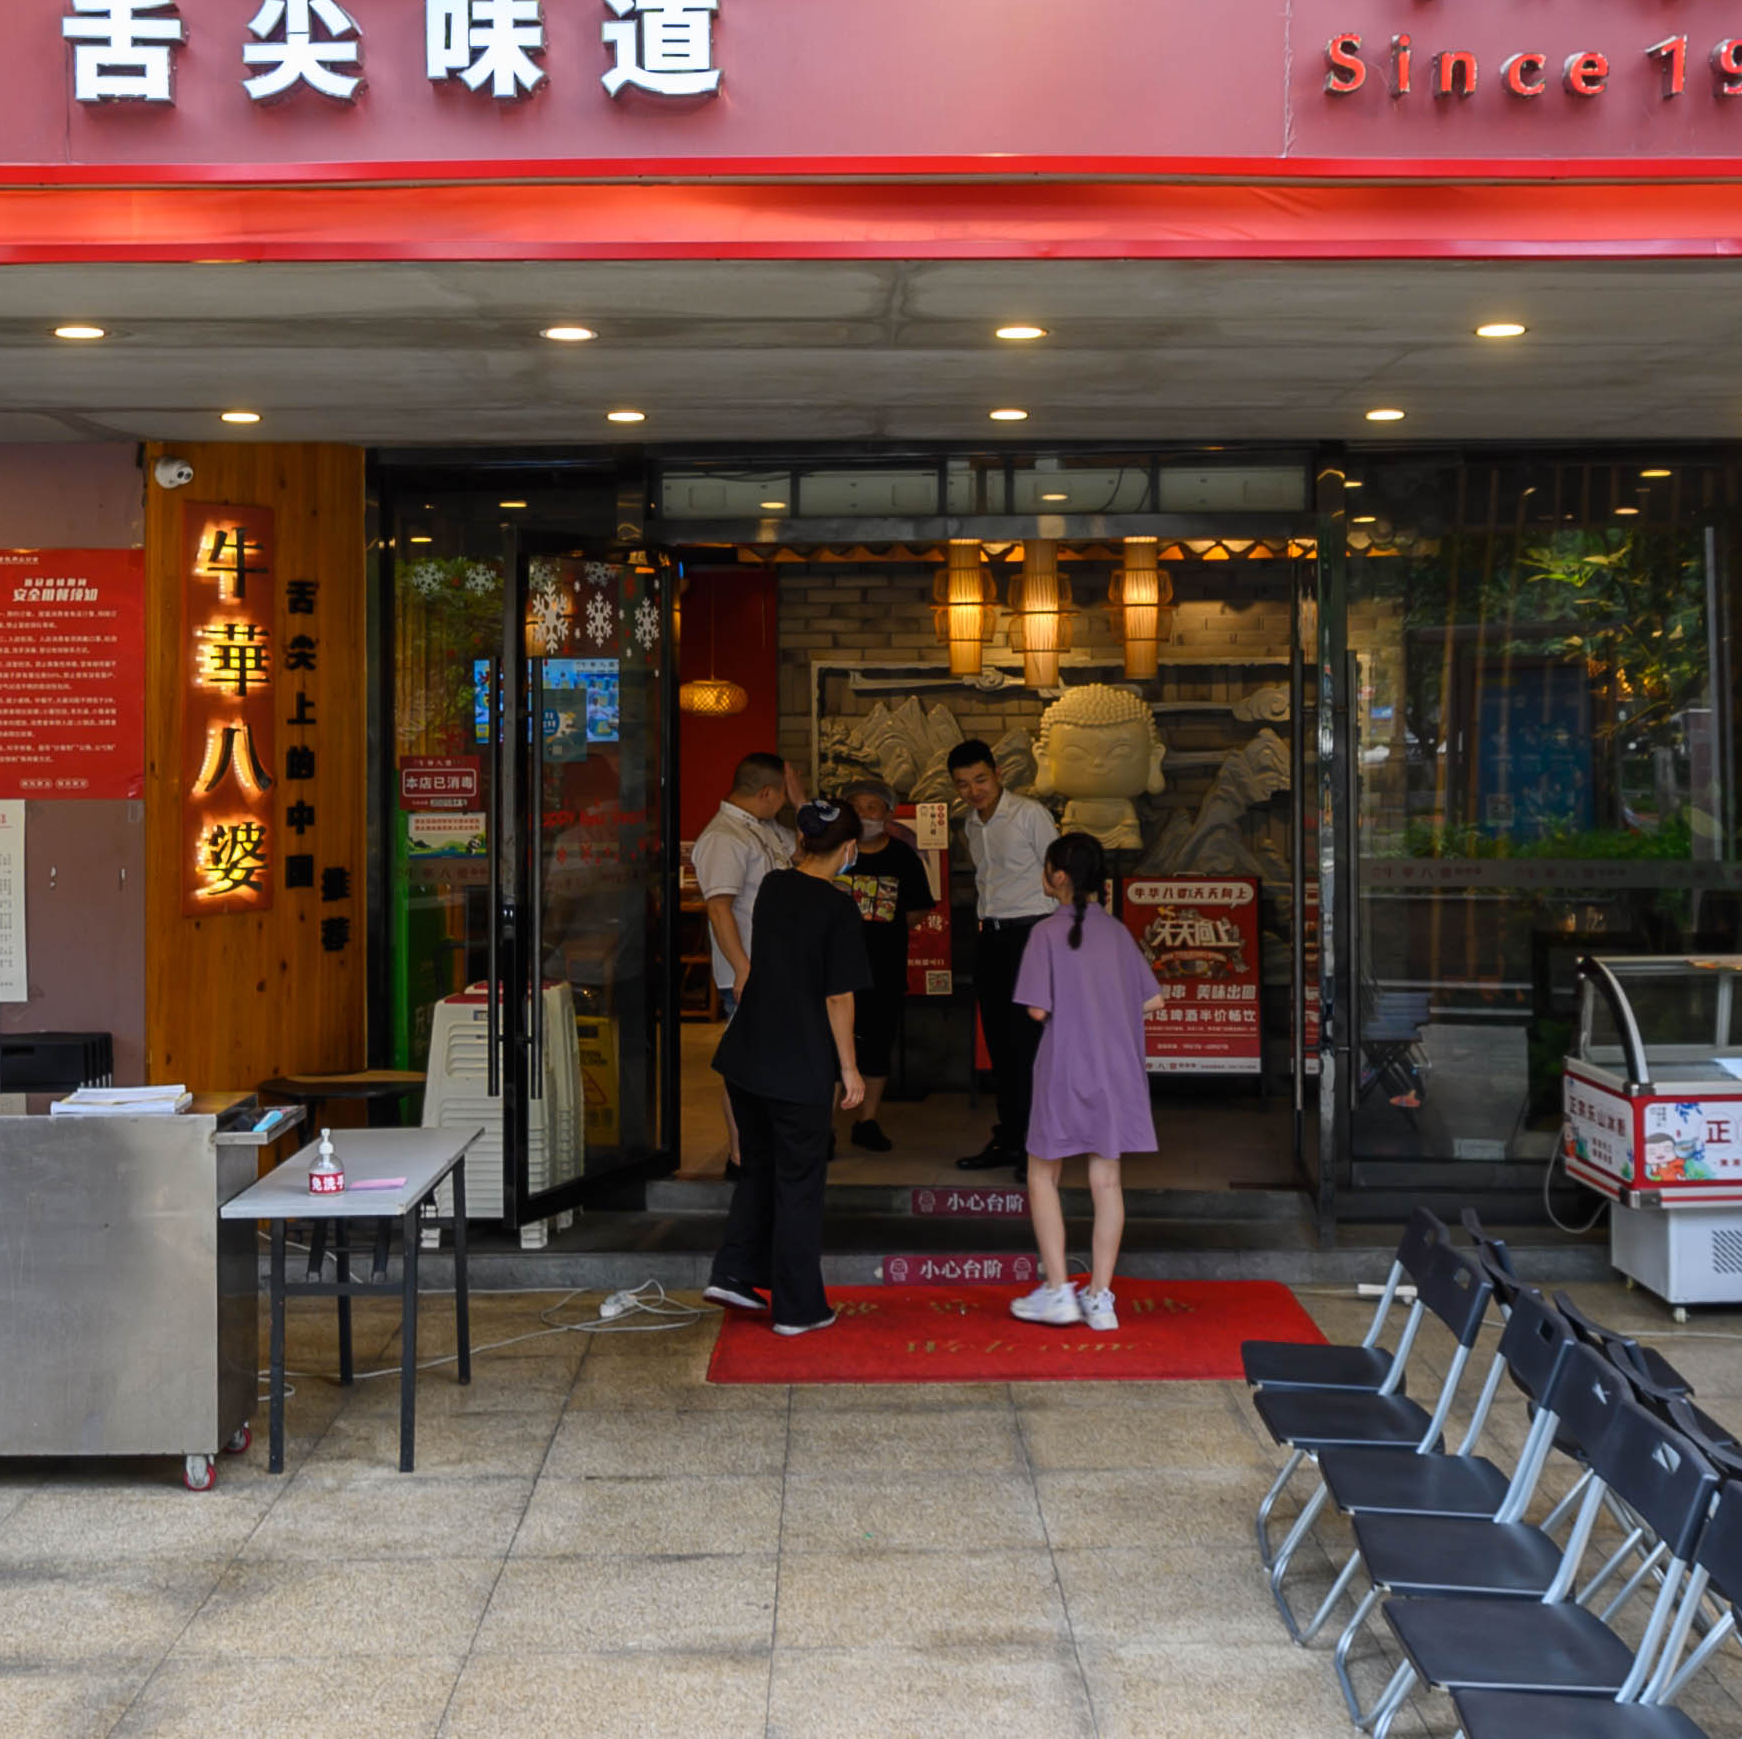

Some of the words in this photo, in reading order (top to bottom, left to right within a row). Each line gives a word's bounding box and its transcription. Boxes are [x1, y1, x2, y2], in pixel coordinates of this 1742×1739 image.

[1324, 31, 1610, 98] Since
[198, 524, 272, 896] 牛華八婆
[405, 775, 474, 790] 本店已消毒
[946, 1193, 1024, 1212] 小心台阶
[919, 1259, 1003, 1279] 小心台阶
